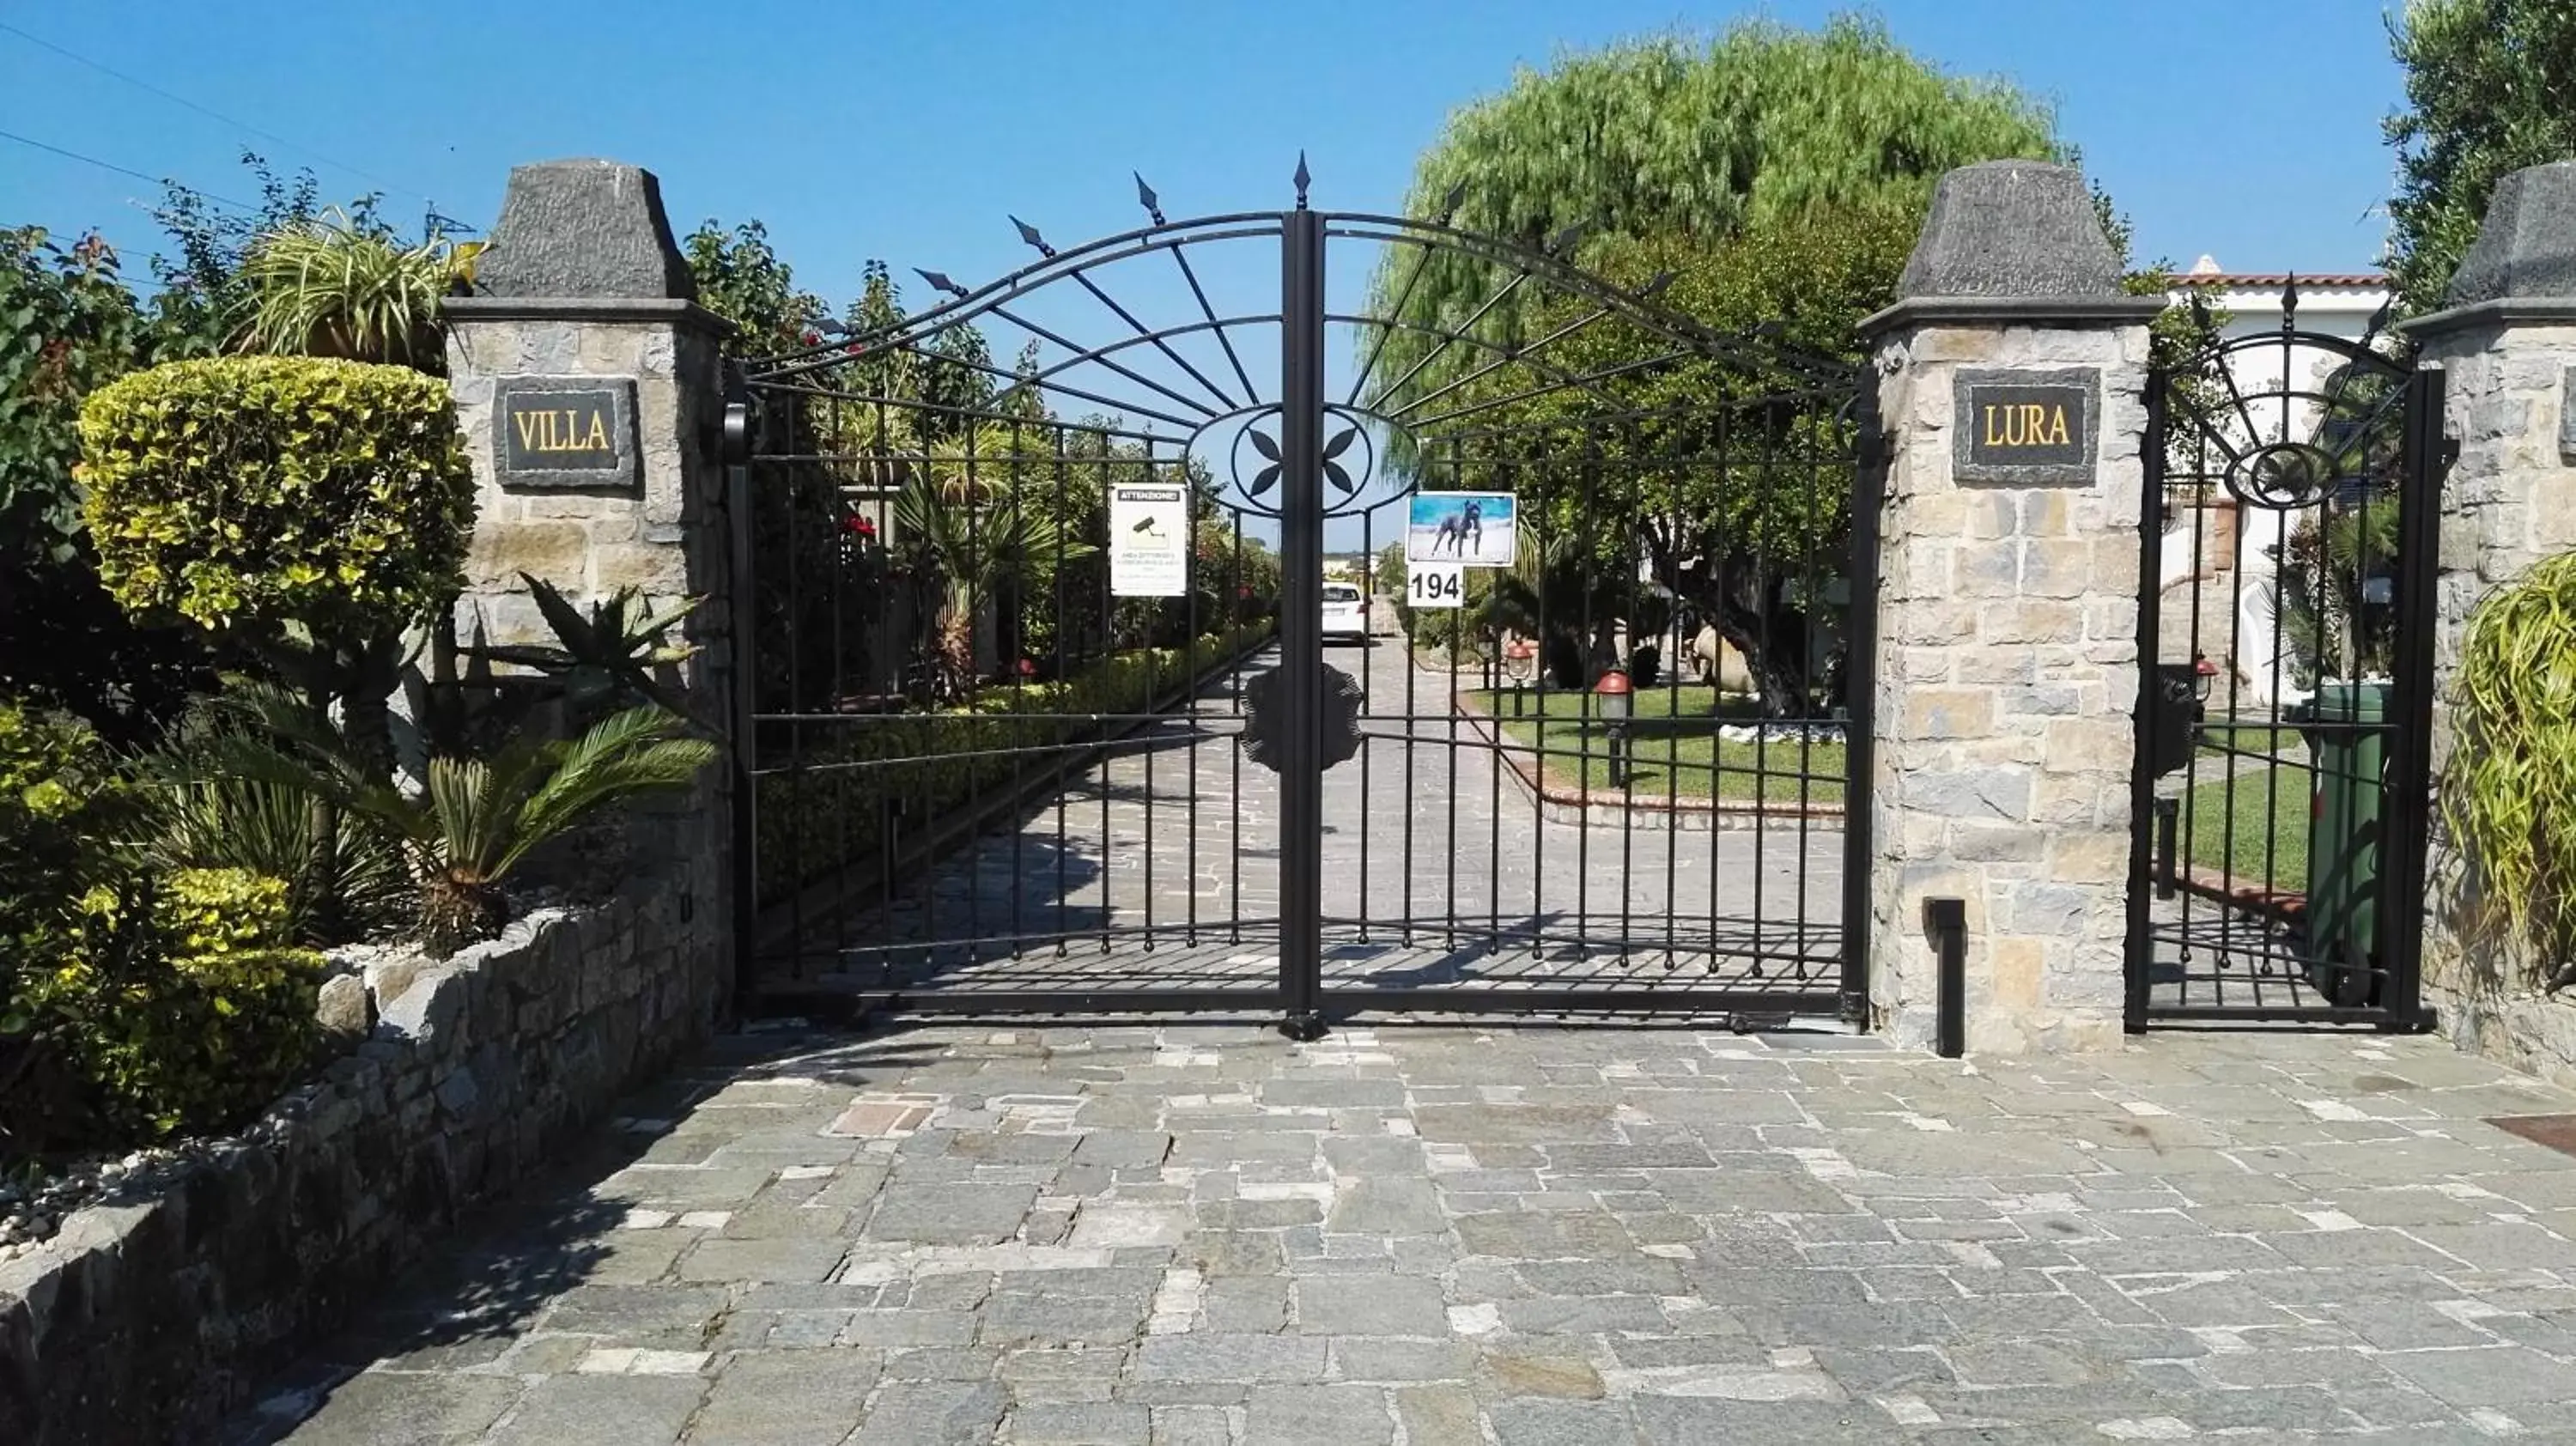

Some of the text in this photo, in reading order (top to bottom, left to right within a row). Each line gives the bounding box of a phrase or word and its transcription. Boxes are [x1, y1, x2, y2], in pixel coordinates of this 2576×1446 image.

[514, 410, 610, 451] VILLA
[1984, 404, 2070, 447] LURA
[1412, 573, 1459, 598] 194
